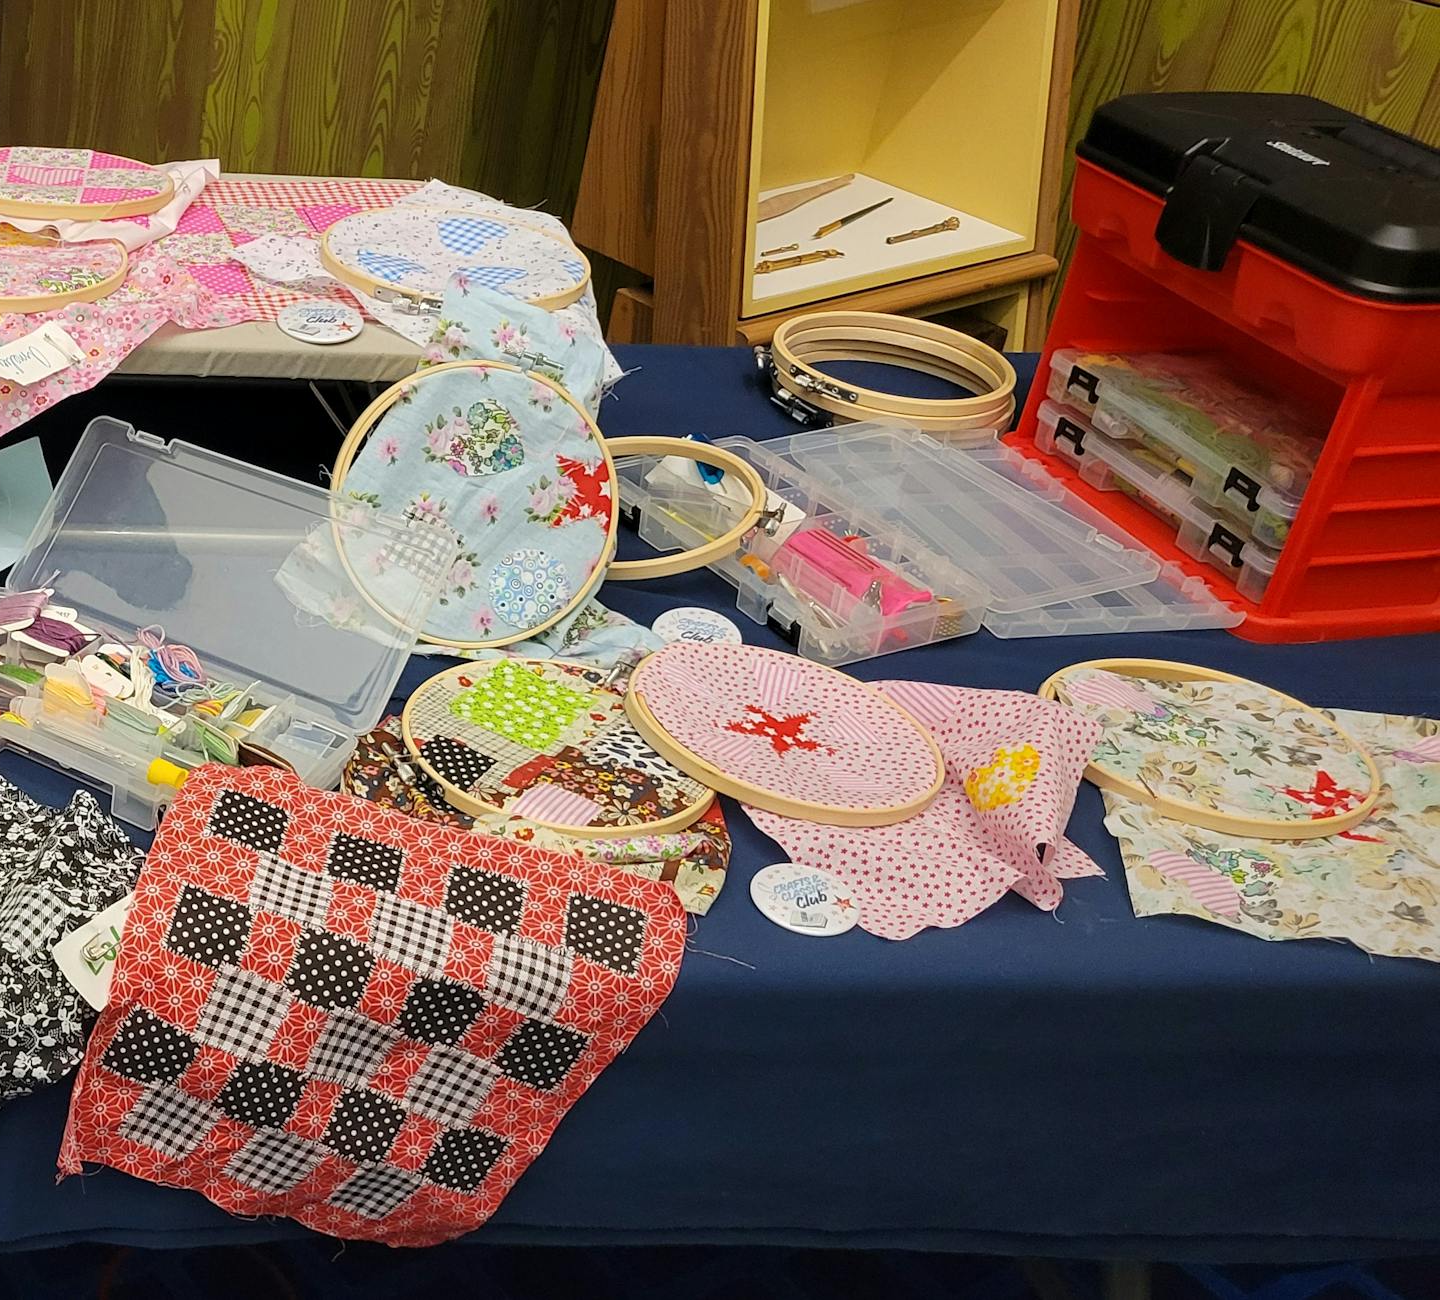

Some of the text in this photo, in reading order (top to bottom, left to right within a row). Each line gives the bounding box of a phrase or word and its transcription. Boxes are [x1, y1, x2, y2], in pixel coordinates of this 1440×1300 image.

[306, 315, 337, 324] Club
[681, 631, 714, 644] Club
[773, 877, 812, 894] CRAFTS
[781, 881, 829, 902] CLASSICS
[796, 890, 827, 908] Club
